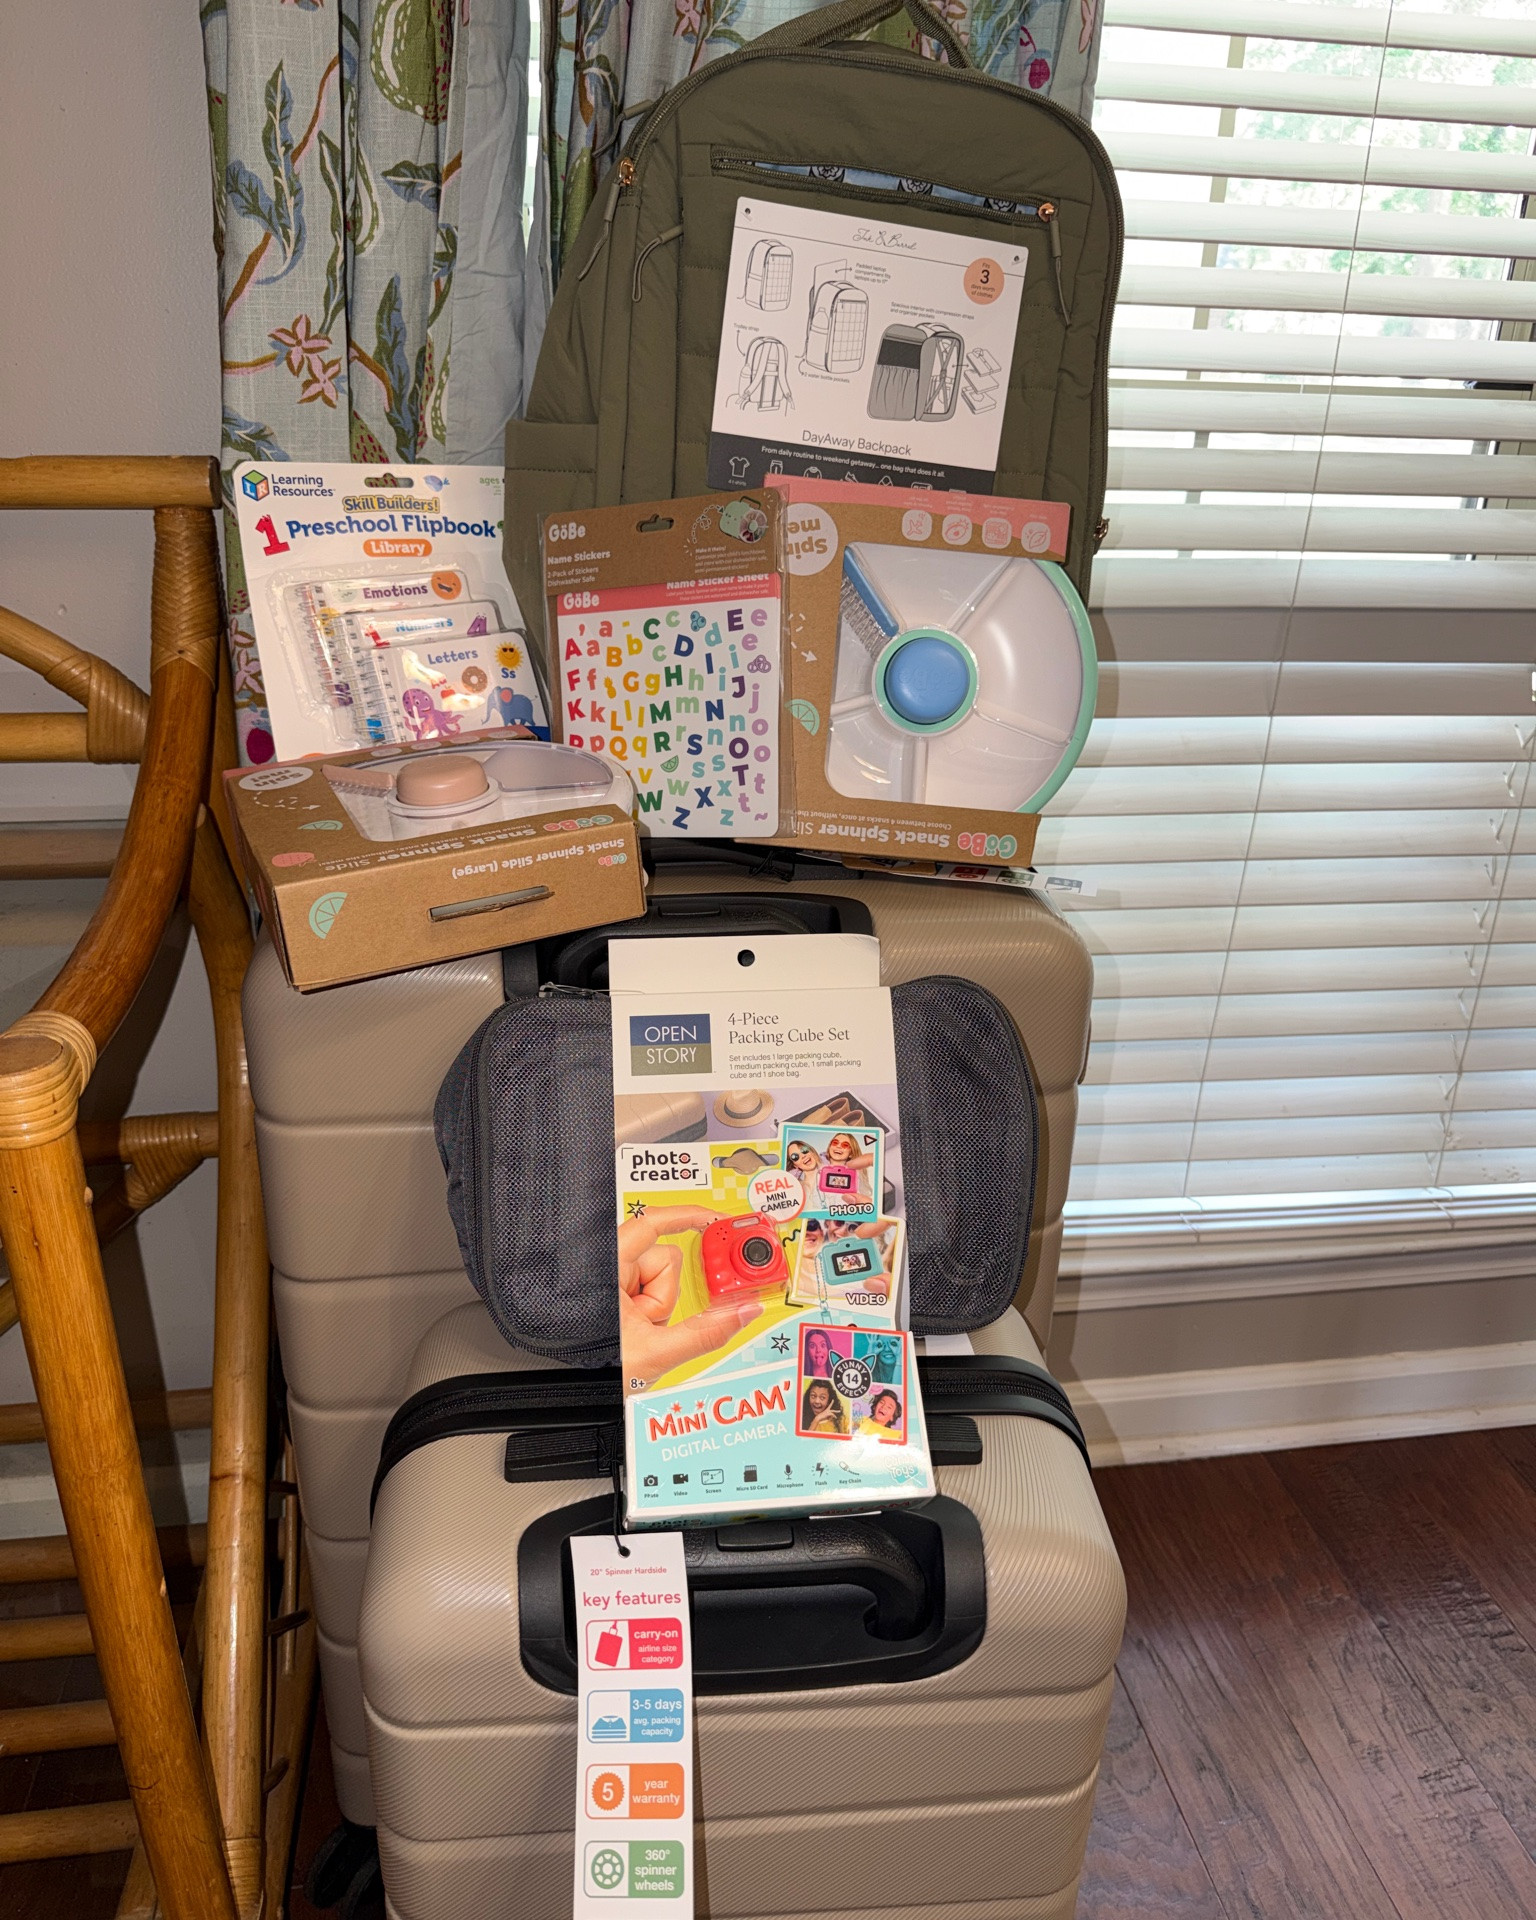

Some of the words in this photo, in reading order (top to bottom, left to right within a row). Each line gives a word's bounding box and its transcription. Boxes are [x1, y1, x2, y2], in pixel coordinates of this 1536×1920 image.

[980, 269, 990, 284] 3
[977, 291, 993, 299] clothes
[802, 430, 855, 450] DayAway
[858, 438, 912, 456] Backpack
[761, 446, 777, 454] From
[778, 448, 792, 457] daily
[793, 451, 814, 460] routine
[823, 454, 850, 464] weekend
[892, 463, 903, 473] bag
[904, 466, 916, 474] that
[917, 468, 931, 476] does
[272, 474, 323, 488] Learning
[480, 477, 500, 486] ages
[273, 486, 334, 498] Resources
[343, 498, 376, 512] Skill
[377, 498, 438, 512] Builders!
[286, 515, 397, 538] Preschool
[402, 515, 496, 537] Flipbook
[370, 541, 425, 556] Library
[547, 553, 573, 566] Name
[573, 550, 611, 562] Stickers
[547, 568, 569, 578] 2-Pack
[574, 567, 599, 576] Stickers
[548, 576, 582, 587] Dishwasher
[583, 575, 596, 583] Safe
[666, 579, 695, 590] Name
[698, 575, 735, 587] Sticker
[737, 572, 769, 583] Sheet
[363, 583, 428, 599] Emotions
[428, 649, 478, 665] Letters
[501, 668, 516, 679] Ss
[810, 811, 837, 819] without
[896, 819, 926, 828] between
[927, 822, 952, 830] Choose
[469, 829, 537, 845] Snack
[818, 824, 890, 842] Spinner
[895, 830, 951, 848] Snack
[377, 842, 465, 862] Spinner
[587, 839, 625, 853] Snack
[957, 832, 1017, 858] GöBe
[536, 845, 584, 862] Spinner
[325, 859, 371, 871] Slide
[452, 860, 498, 879] (Large)
[501, 856, 533, 869] Slide
[728, 1012, 779, 1026] 4-Piece
[645, 1025, 697, 1042] OPEN
[729, 1029, 784, 1046] Packing
[788, 1028, 824, 1042] Cube
[829, 1027, 850, 1041] Set
[647, 1047, 697, 1064] STORY
[729, 1054, 741, 1062] Set
[743, 1053, 770, 1061] includes
[776, 1053, 793, 1062] large
[795, 1052, 821, 1061] packing
[823, 1051, 841, 1059] cube,
[734, 1062, 761, 1070] medium
[763, 1062, 789, 1071] packing
[791, 1061, 810, 1069] cube,
[816, 1060, 836, 1068] small
[837, 1059, 861, 1069] packing
[730, 1071, 747, 1079] cube
[768, 1070, 785, 1078] shoe
[630, 1168, 699, 1181] creator
[755, 1177, 794, 1195] REAL
[766, 1191, 787, 1202] MINI
[761, 1199, 799, 1213] CAMERA
[830, 1203, 874, 1216] PHOTO
[846, 1293, 887, 1305] VIDEO
[833, 1359, 868, 1374] FUNNY
[630, 1378, 645, 1389] 8+
[846, 1373, 859, 1385] 14
[836, 1384, 867, 1398] EFFECTS
[662, 1434, 720, 1461] DIGITAL
[724, 1422, 787, 1447] CAMERA
[590, 1568, 602, 1576] 20"
[605, 1567, 632, 1577] Spinner
[634, 1566, 667, 1575] Hardside
[583, 1592, 610, 1610] key
[615, 1590, 681, 1605] features
[634, 1630, 678, 1640] carry-on
[638, 1645, 660, 1653] airline
[662, 1644, 677, 1652] size
[641, 1655, 674, 1664] category
[633, 1700, 651, 1710] 3-5
[655, 1699, 682, 1712] days
[633, 1717, 649, 1725] avg.
[651, 1716, 681, 1725] packing
[641, 1728, 673, 1737] capacity
[602, 1782, 614, 1802] 5
[644, 1780, 669, 1791] year
[632, 1792, 680, 1806] warranty
[645, 1849, 670, 1861] 360°
[634, 1864, 677, 1878] spinner
[634, 1879, 674, 1890] wheels
